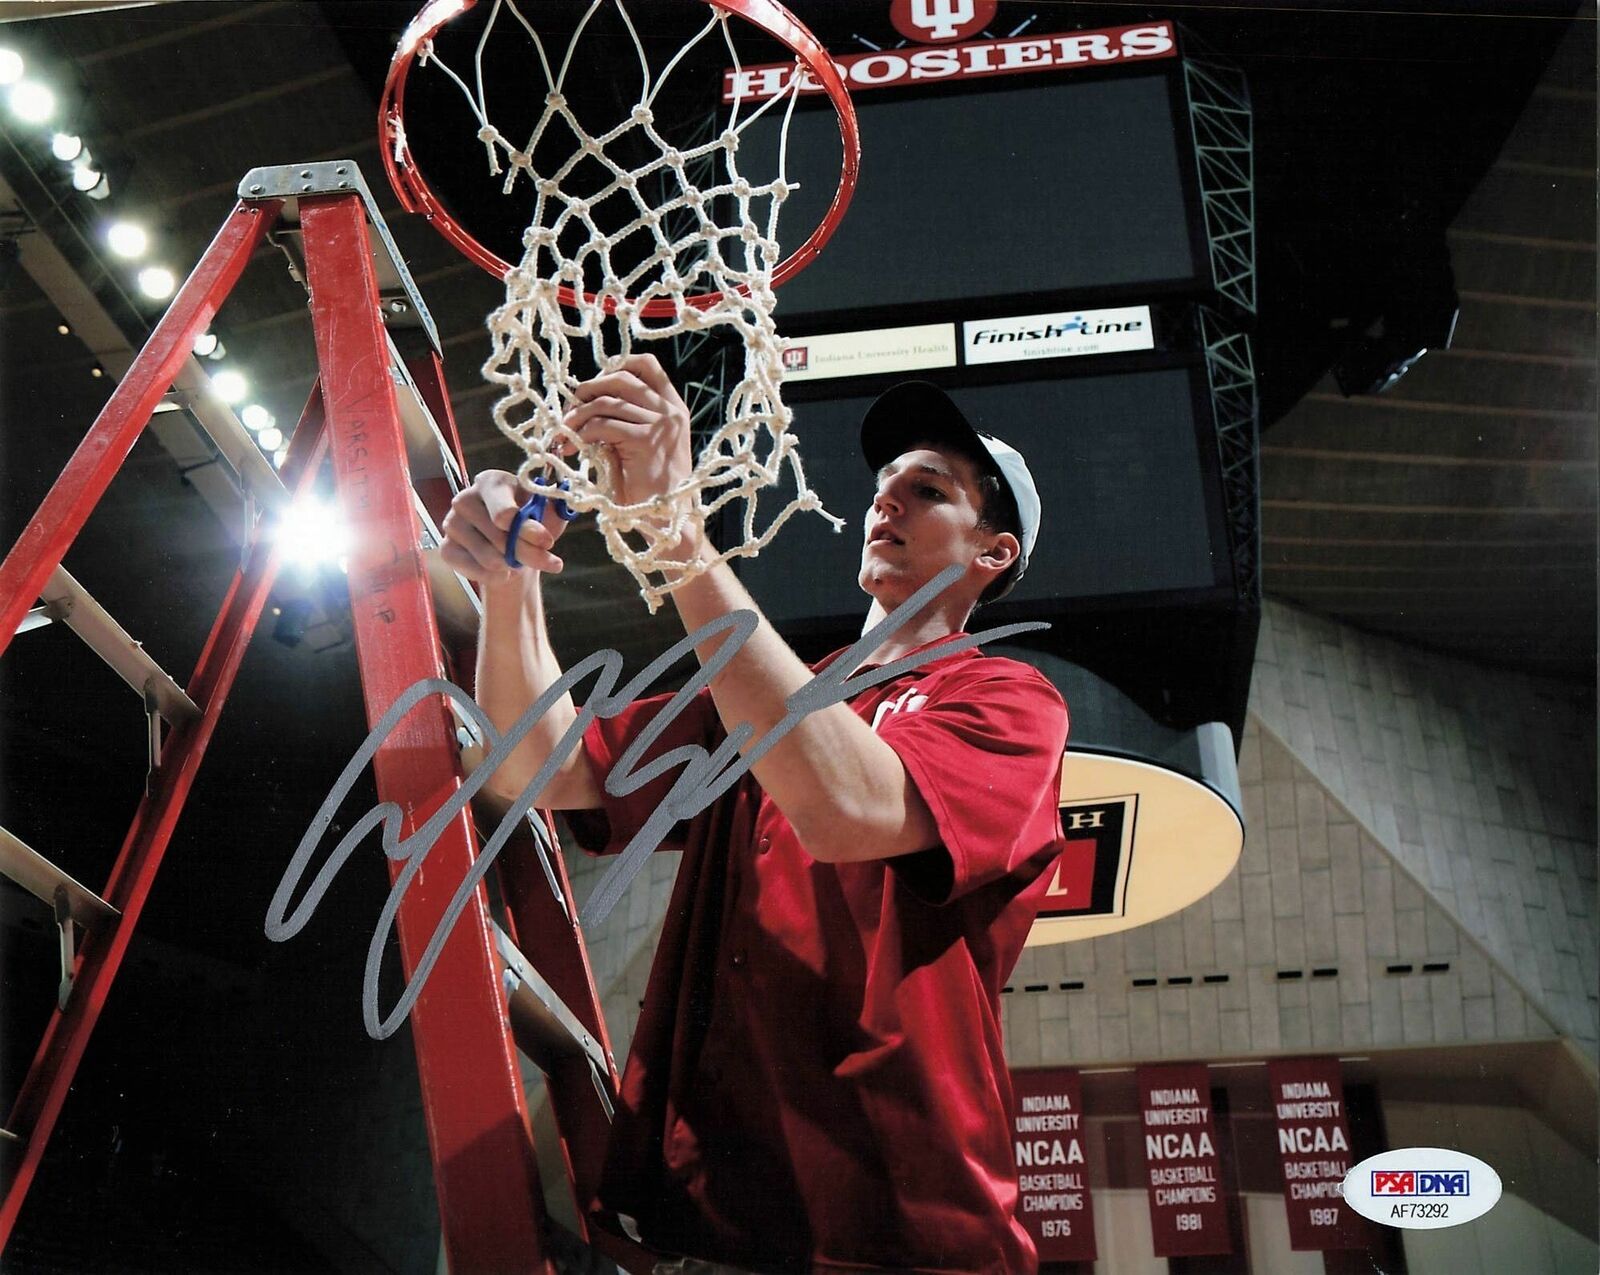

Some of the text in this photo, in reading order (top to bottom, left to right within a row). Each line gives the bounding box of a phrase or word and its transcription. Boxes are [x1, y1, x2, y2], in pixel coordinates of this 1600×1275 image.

[723, 26, 1173, 99] HOOSIERS
[973, 320, 1142, 345] Finish Line
[815, 344, 949, 364] Indiana University Health
[1023, 344, 1099, 357] finishline.com
[1150, 1089, 1200, 1106] INDIANA
[1282, 1082, 1331, 1099] INDIANA
[1022, 1095, 1071, 1113] INDIANA
[1276, 1102, 1340, 1120] UNIVERSITY
[1015, 1114, 1079, 1133] UNIVERSITY
[1144, 1108, 1208, 1126] UNIVERSITY
[1145, 1132, 1215, 1160] NCAA
[1278, 1126, 1349, 1154] NCAA
[1015, 1139, 1084, 1167] NCAA
[1019, 1173, 1084, 1192] BASKETBALL
[1150, 1166, 1216, 1186] BASKETBALL
[1375, 1172, 1465, 1195] PSA DNA
[1023, 1193, 1083, 1213] CHAMPIONS
[1155, 1187, 1216, 1207] CHAMPIONS
[1310, 1208, 1339, 1226] 1987
[1390, 1203, 1449, 1218] AF73292
[1042, 1219, 1071, 1238] 1976
[1176, 1213, 1203, 1231] 1981
